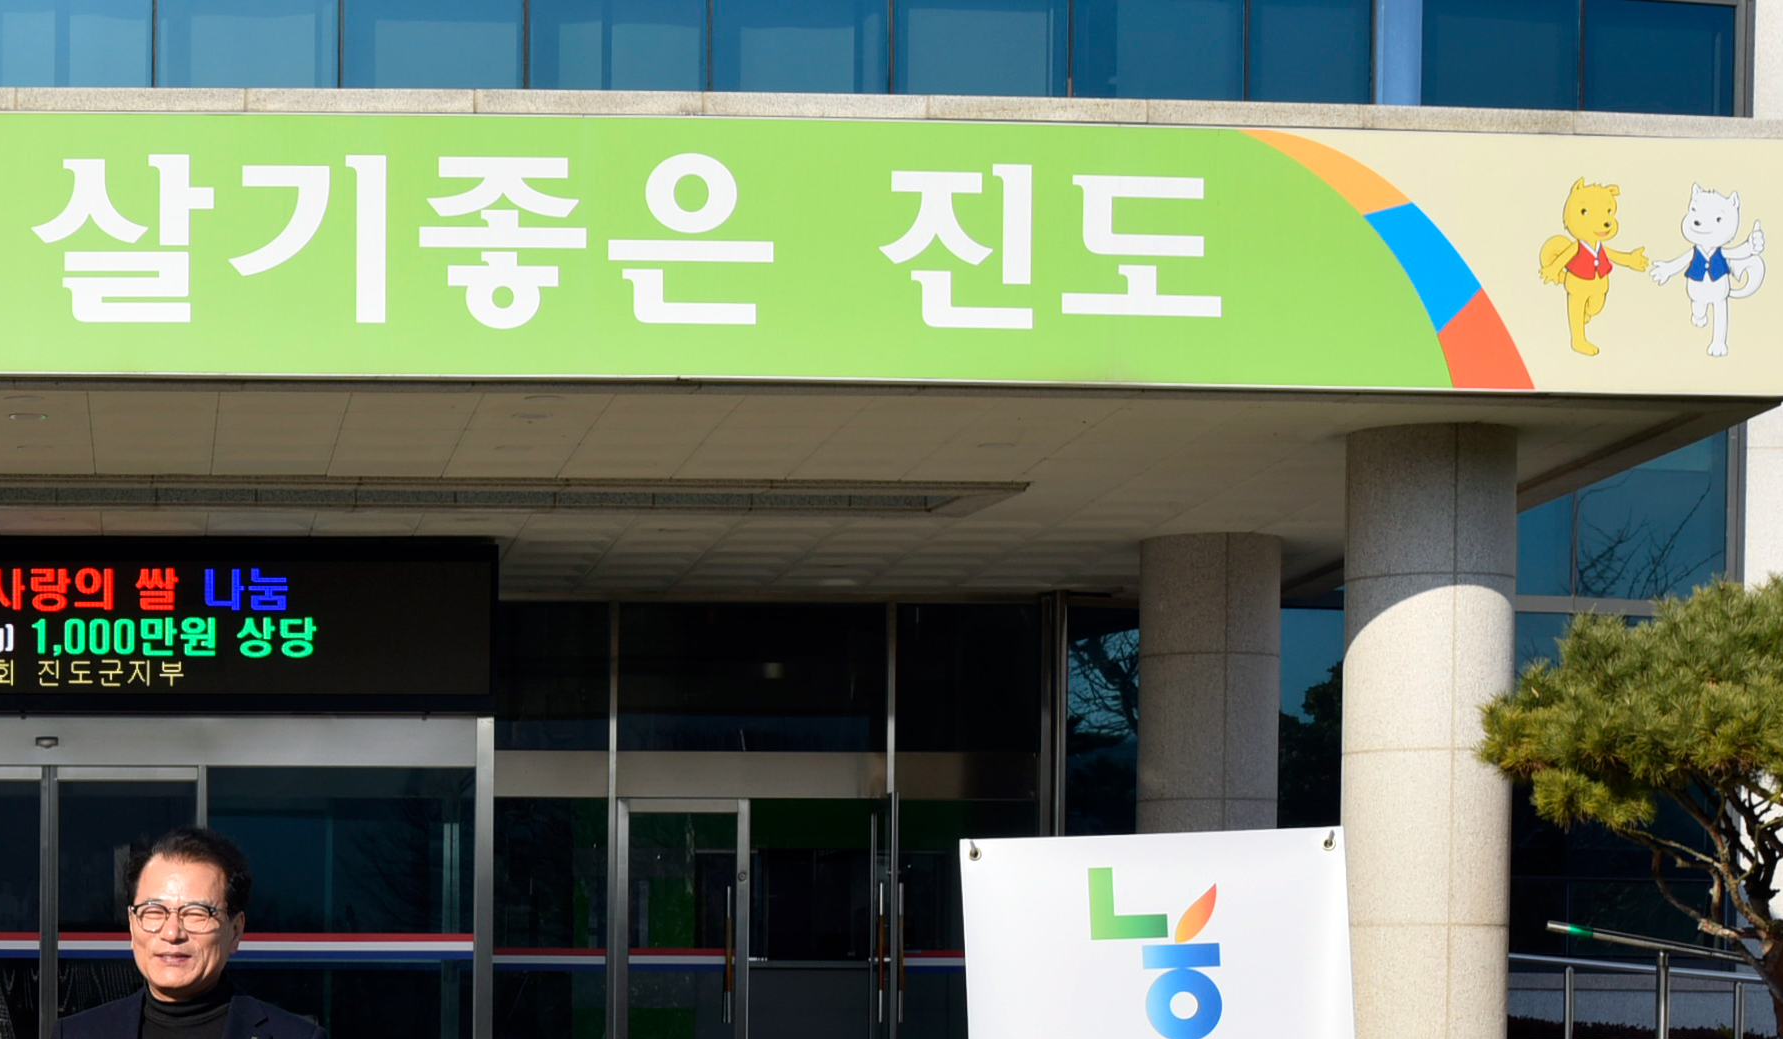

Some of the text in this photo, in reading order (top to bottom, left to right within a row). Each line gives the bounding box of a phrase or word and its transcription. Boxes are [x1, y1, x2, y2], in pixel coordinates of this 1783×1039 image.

[32, 153, 775, 329] 살기좋은
[879, 164, 1223, 329] 진도
[136, 568, 179, 610] 쌀
[205, 568, 289, 611] 나눔
[31, 617, 216, 658] 1,000만원
[237, 617, 317, 658] 상당
[39, 660, 184, 686] 진도군지부
